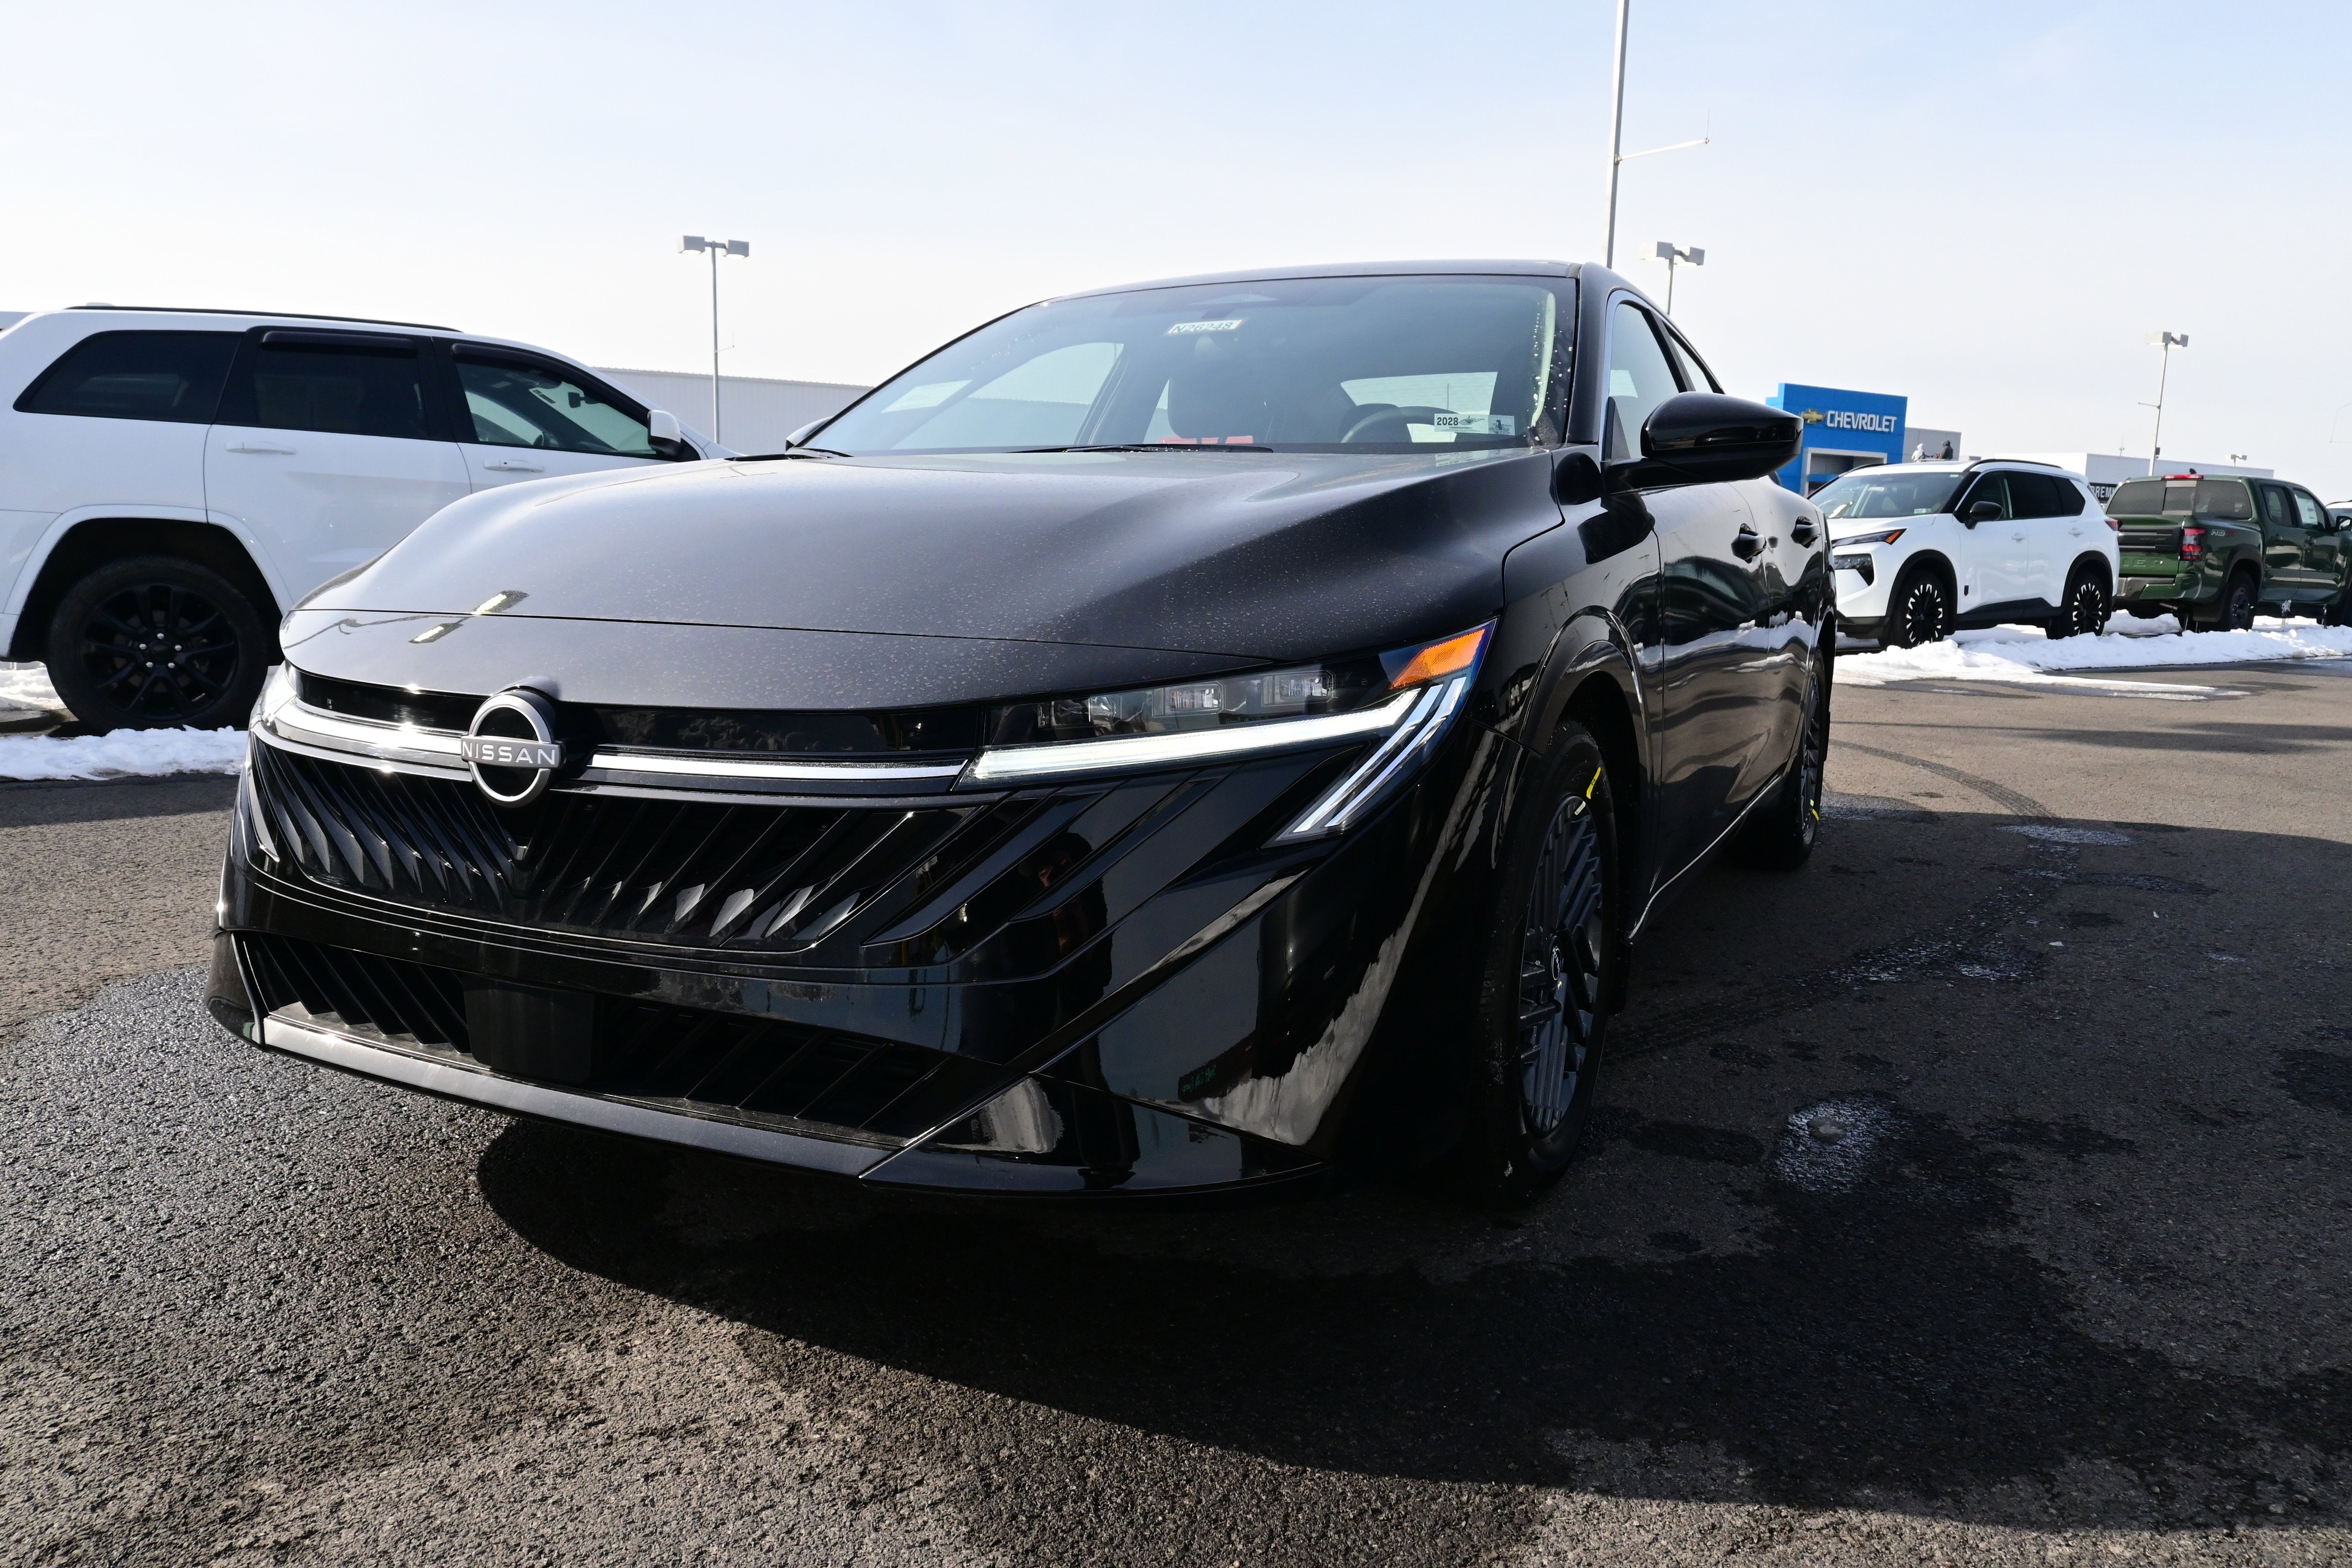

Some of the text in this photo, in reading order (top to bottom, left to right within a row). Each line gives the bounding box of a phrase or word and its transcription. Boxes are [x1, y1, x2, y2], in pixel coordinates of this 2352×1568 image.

[1172, 322, 1233, 332] N26248
[1437, 417, 1459, 425] 2028
[1827, 411, 1897, 432] CHEVROLET
[462, 741, 555, 765] NISSAN
